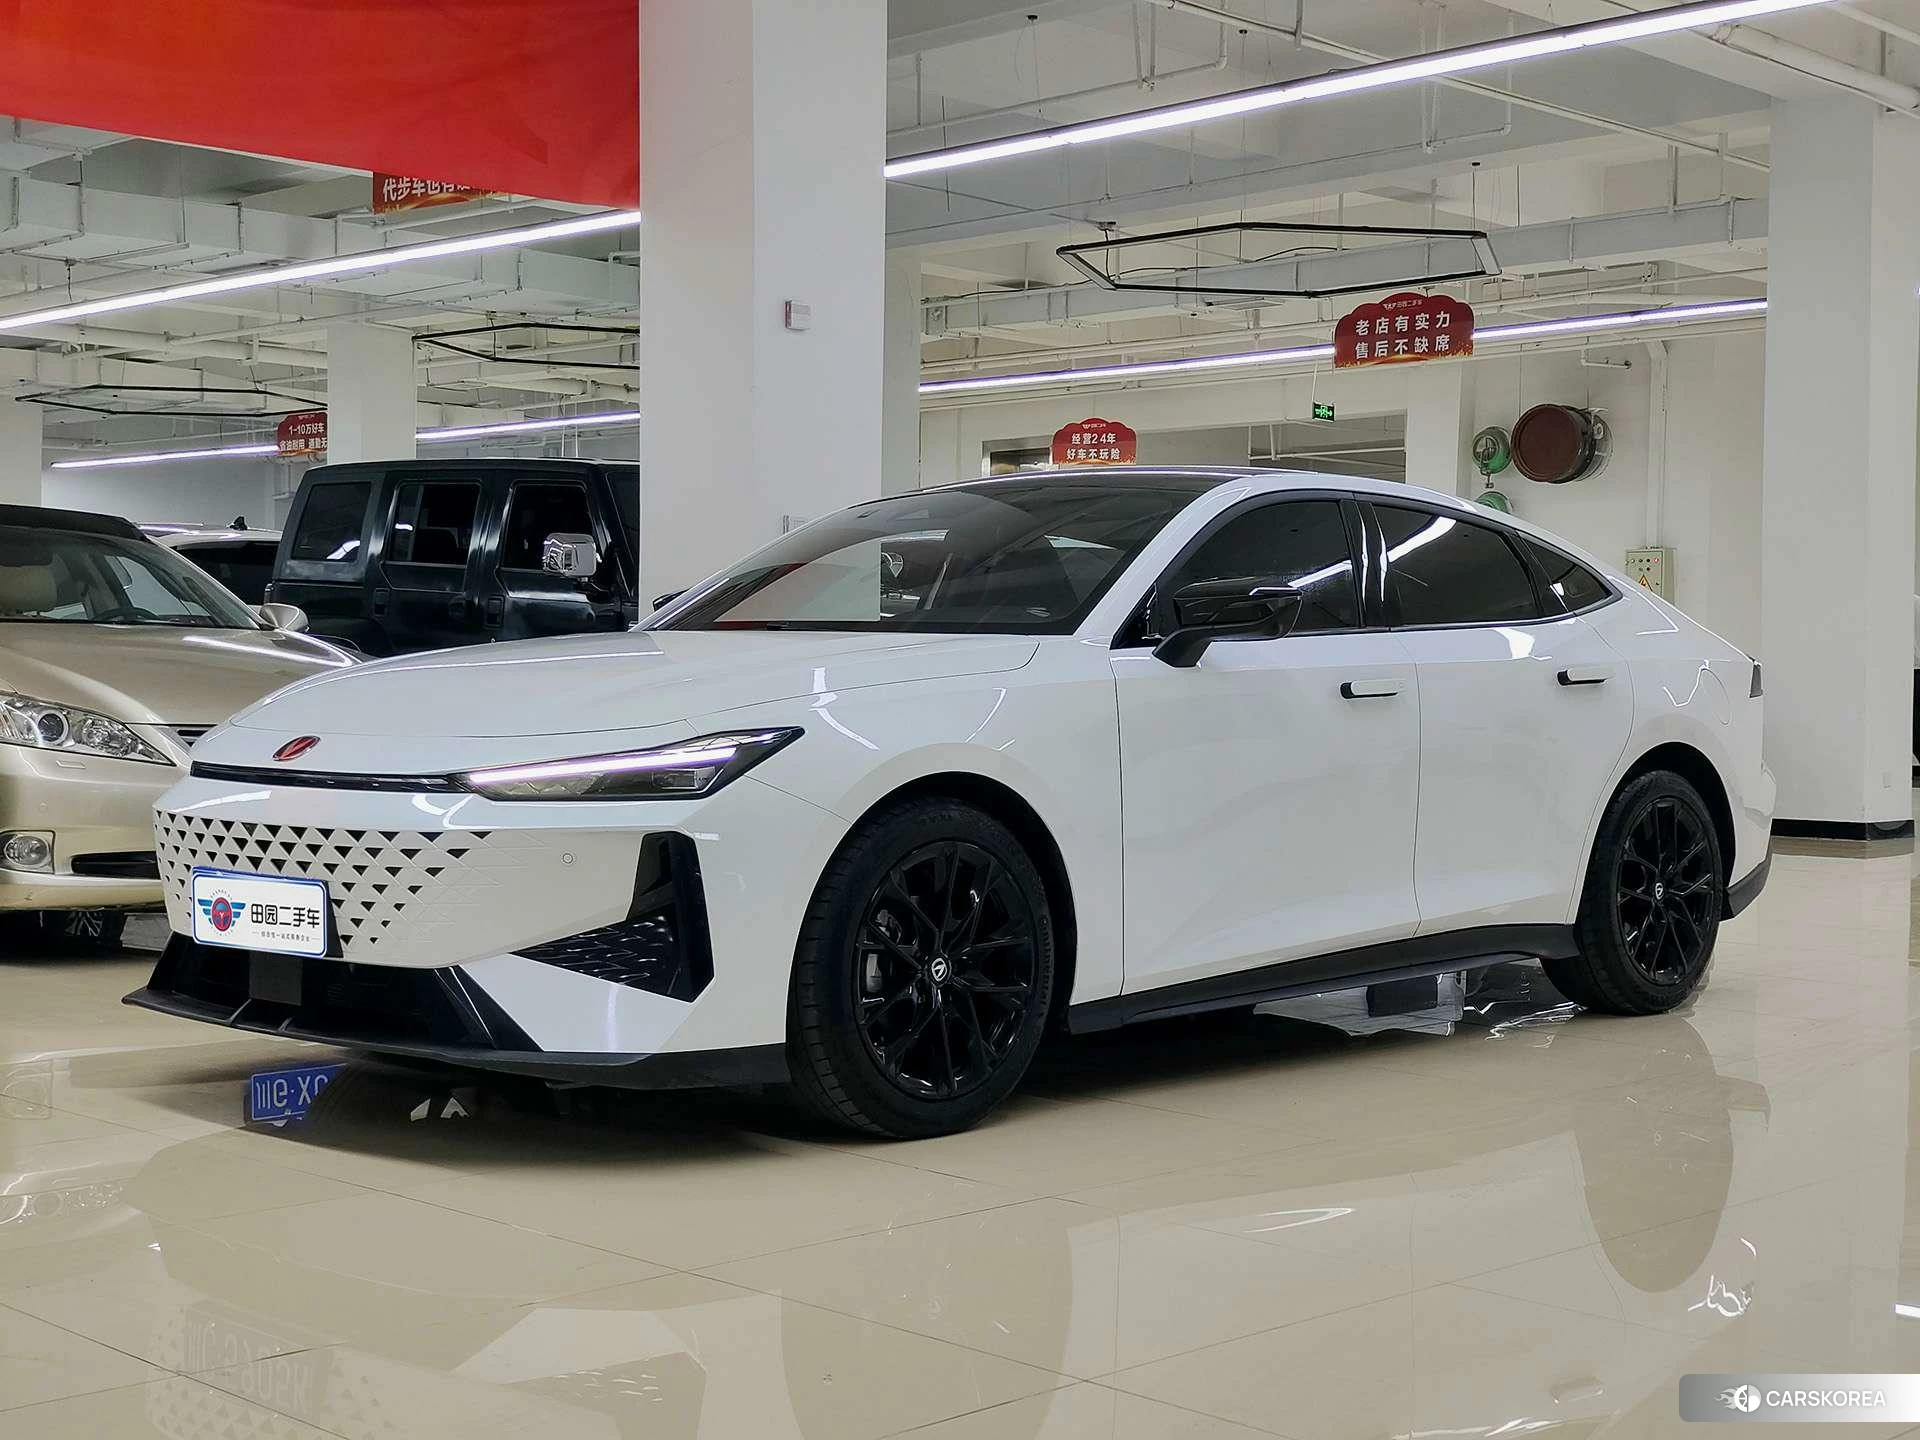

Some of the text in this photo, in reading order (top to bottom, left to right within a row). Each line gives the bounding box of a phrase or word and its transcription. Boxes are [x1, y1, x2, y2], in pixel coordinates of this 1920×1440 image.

[1355, 311, 1451, 336] 老店有实力
[1355, 334, 1451, 360] 售后不缺席
[1071, 432, 1116, 445] 经营24年
[1066, 448, 1121, 460] 好车不玩险
[251, 903, 320, 929] 田园二手车
